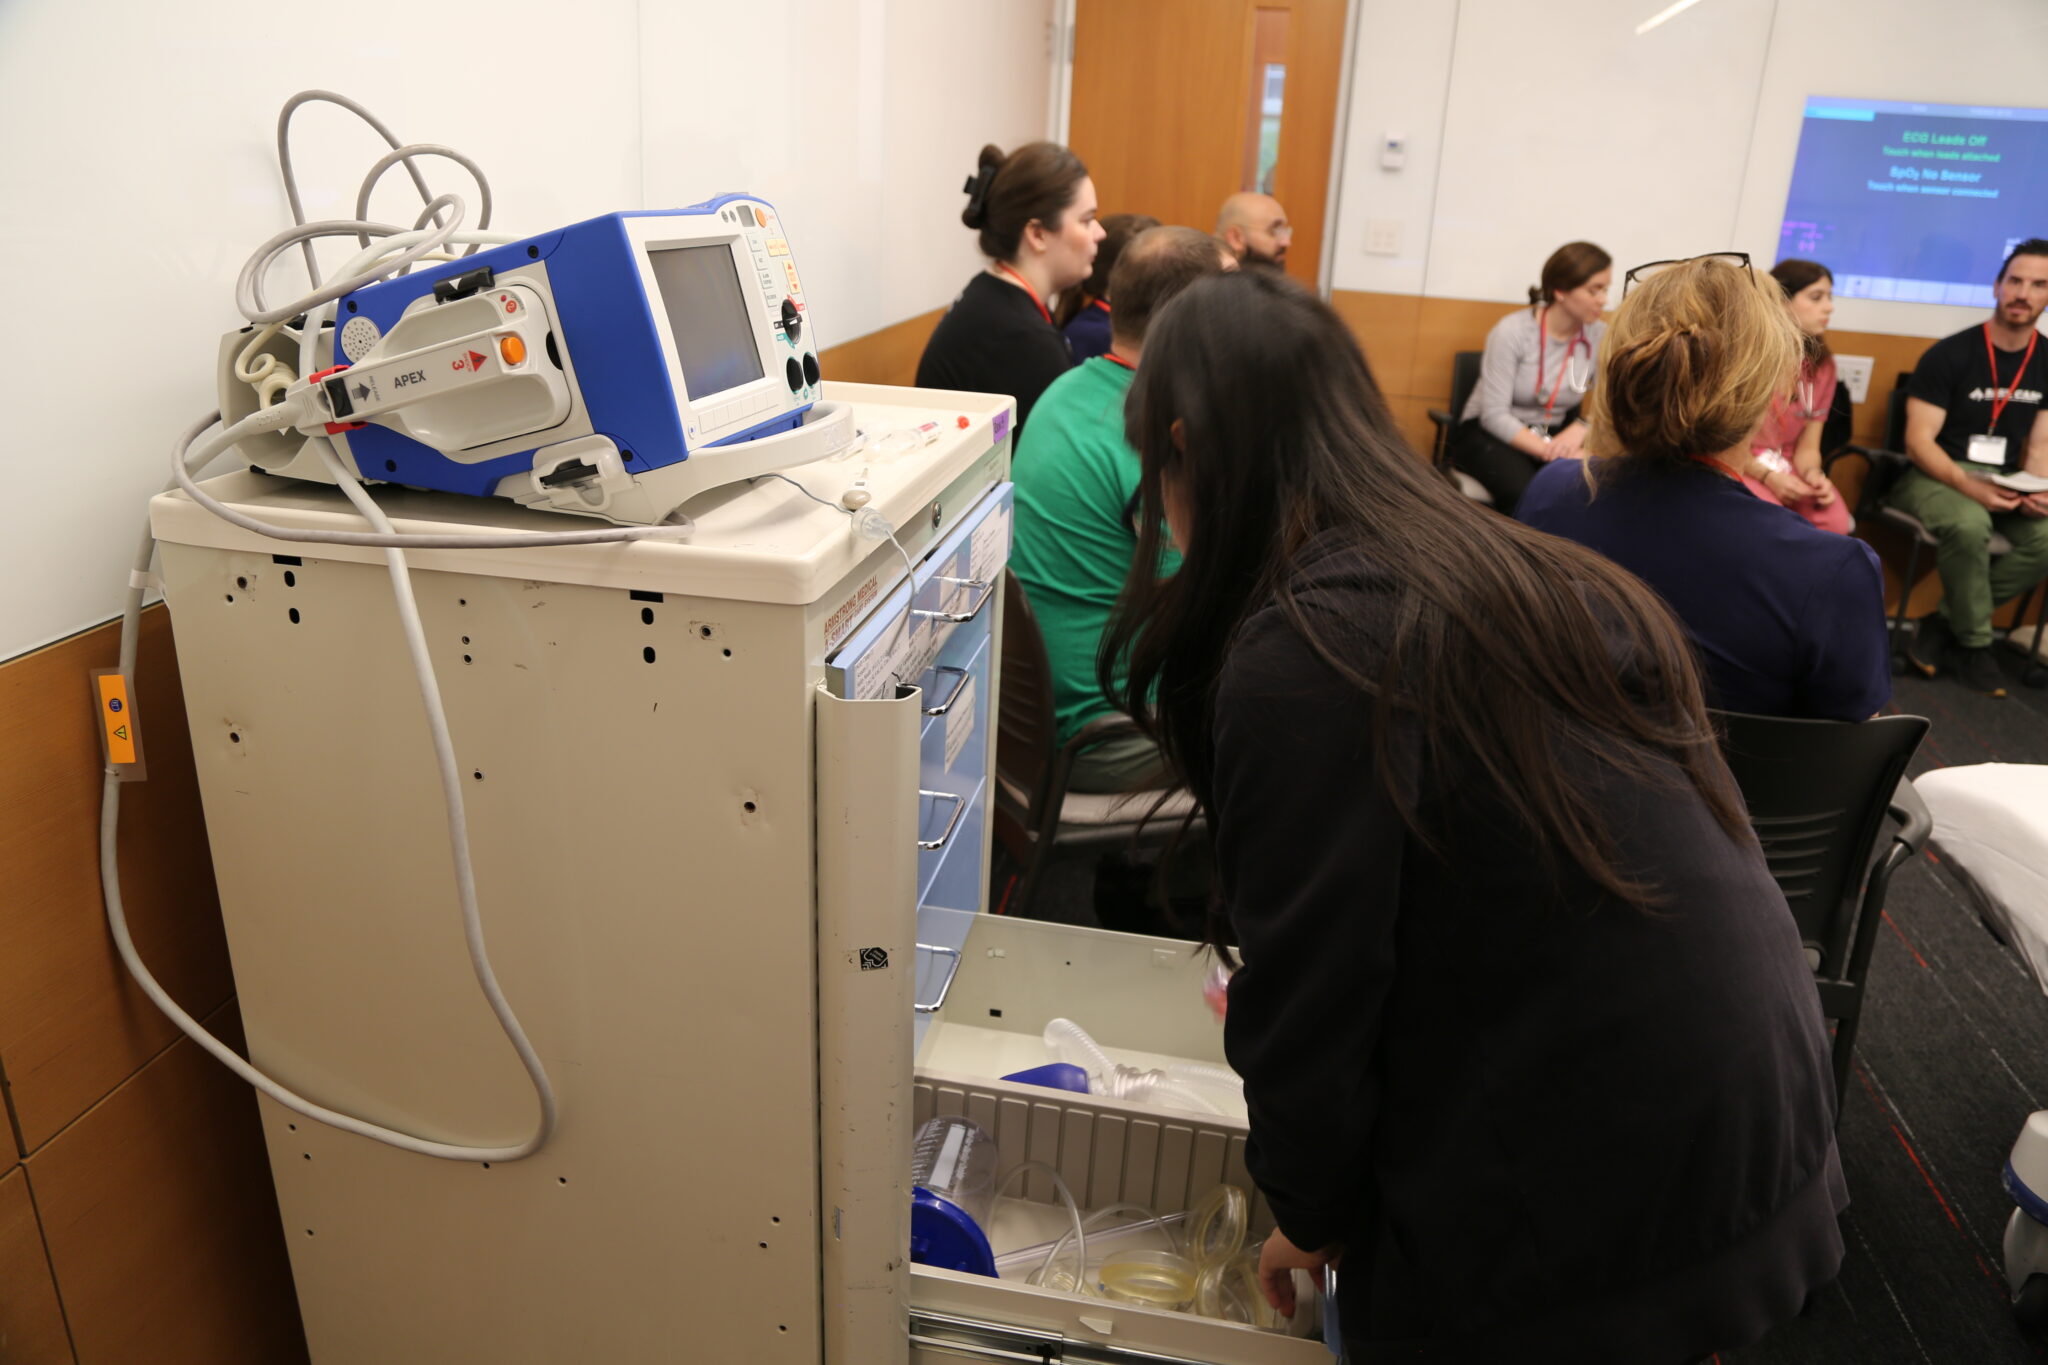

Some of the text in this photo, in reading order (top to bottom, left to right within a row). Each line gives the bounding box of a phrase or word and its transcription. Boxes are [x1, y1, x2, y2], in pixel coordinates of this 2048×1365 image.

[1931, 132, 1966, 146] Leads
[1968, 134, 1988, 147] Off
[1922, 167, 1938, 180] No
[1940, 169, 1982, 183] Sensor
[452, 360, 464, 371] 3
[393, 369, 427, 389] APEX
[369, 376, 381, 401] RELEASE
[824, 575, 878, 635] ARMSTRONG MEDICAL
